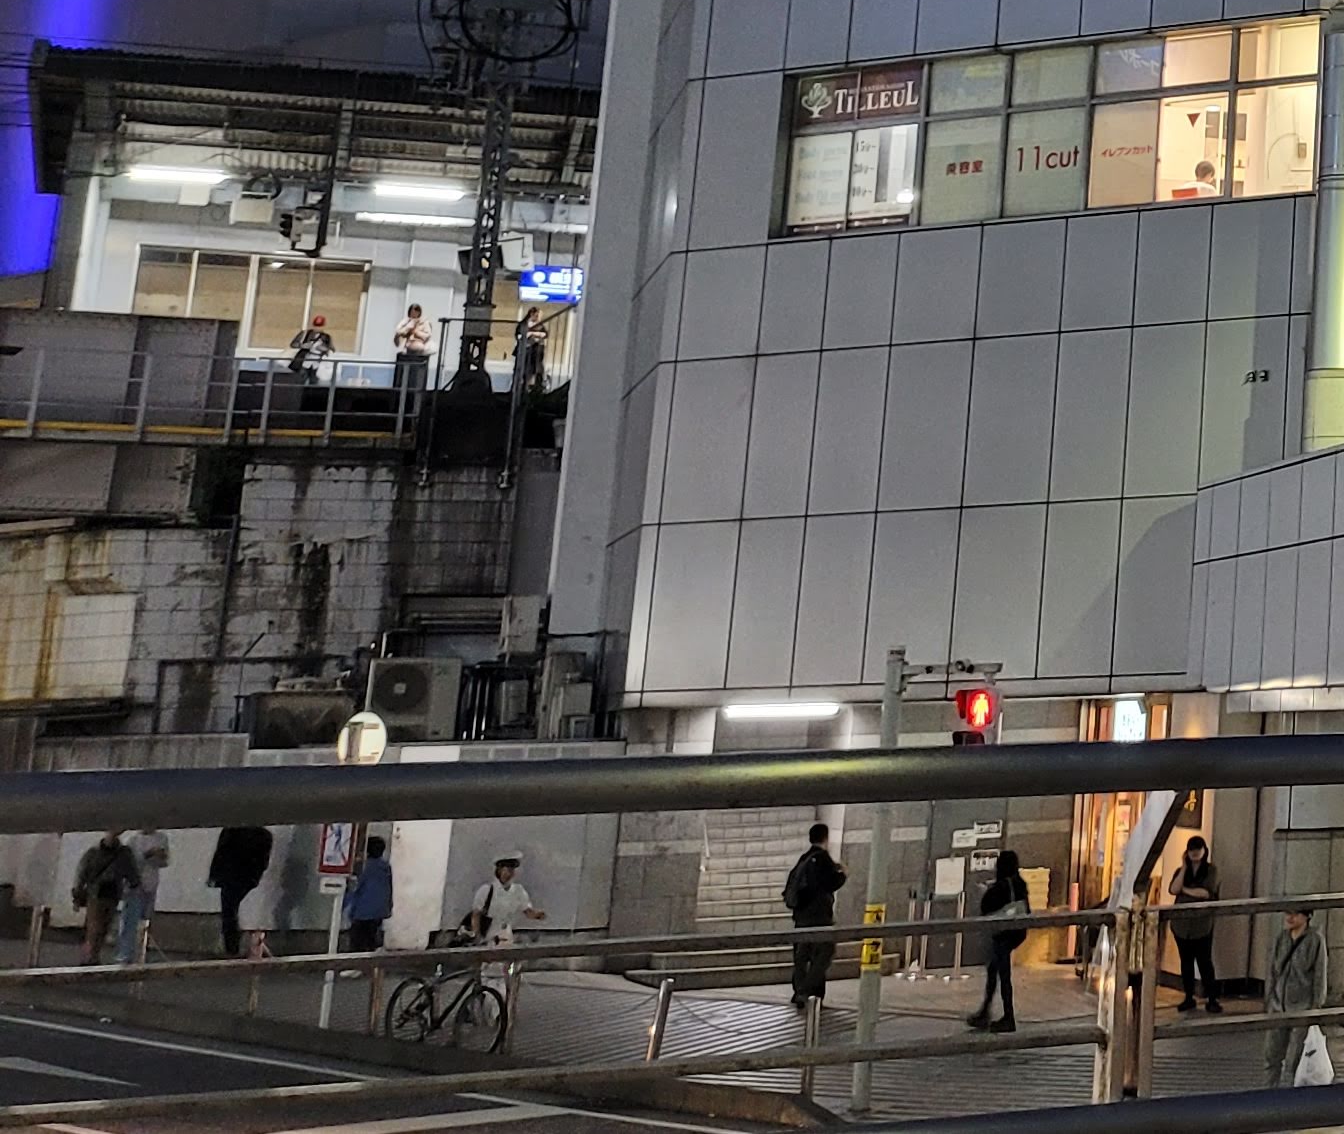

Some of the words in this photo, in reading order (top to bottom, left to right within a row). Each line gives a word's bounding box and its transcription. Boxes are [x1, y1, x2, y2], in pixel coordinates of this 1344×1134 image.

[1017, 145, 1081, 172] 11cut
[1101, 144, 1154, 157] イレブンカット
